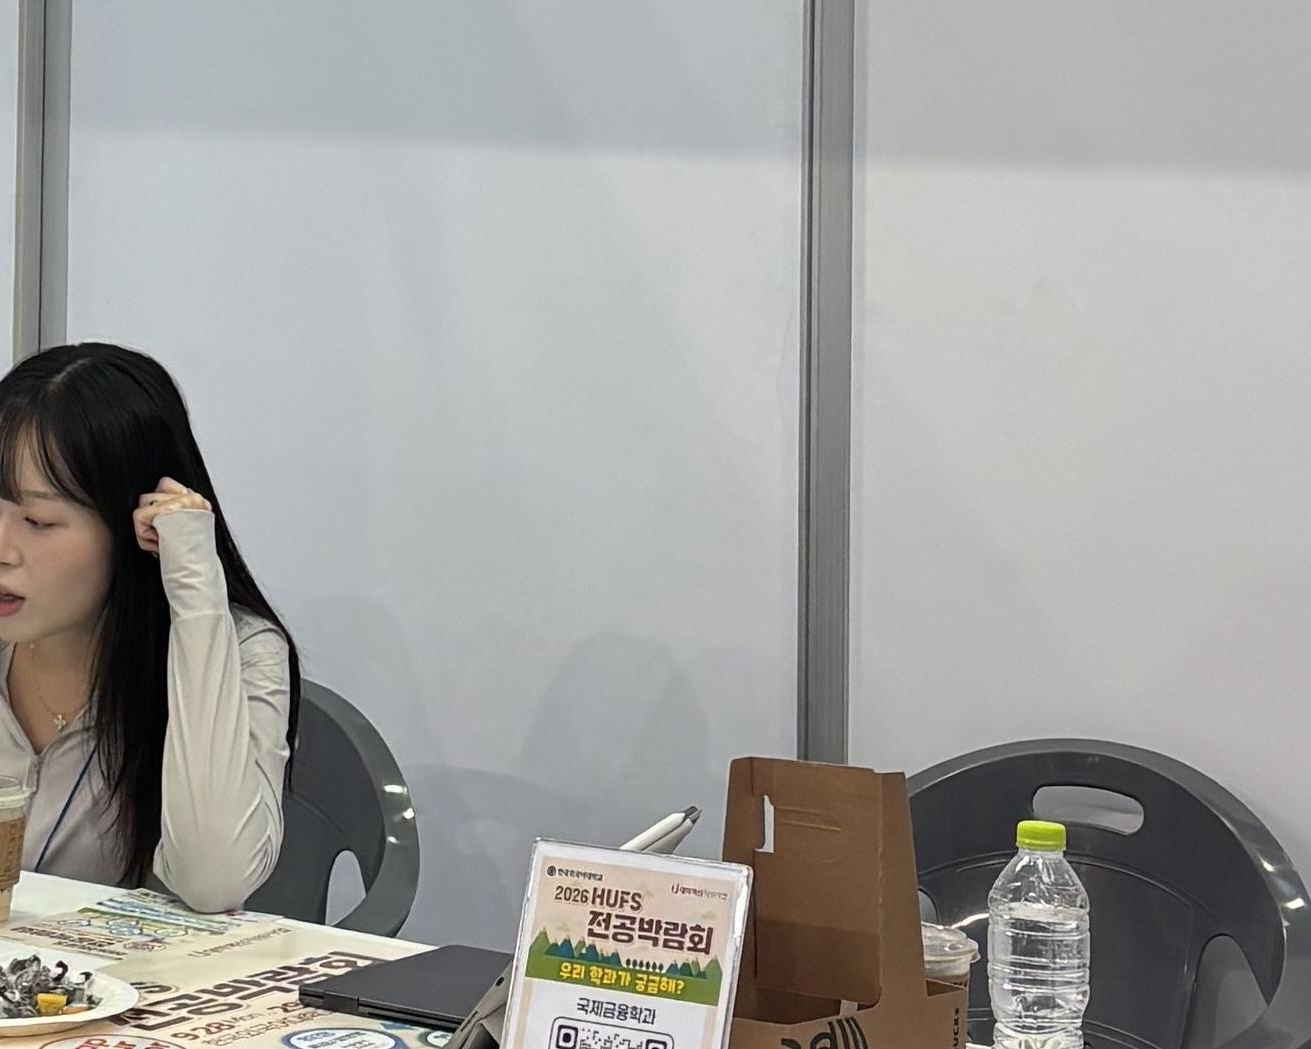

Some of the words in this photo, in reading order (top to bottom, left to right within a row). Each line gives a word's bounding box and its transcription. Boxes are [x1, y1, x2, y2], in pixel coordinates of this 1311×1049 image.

[555, 885, 590, 904] 2026
[591, 887, 642, 912] HUFS
[587, 910, 714, 955] 전공박람회
[560, 962, 585, 980] 우리
[590, 966, 632, 987] 학과가
[635, 973, 685, 994] 궁금해?
[576, 997, 657, 1025] 국제금융학과
